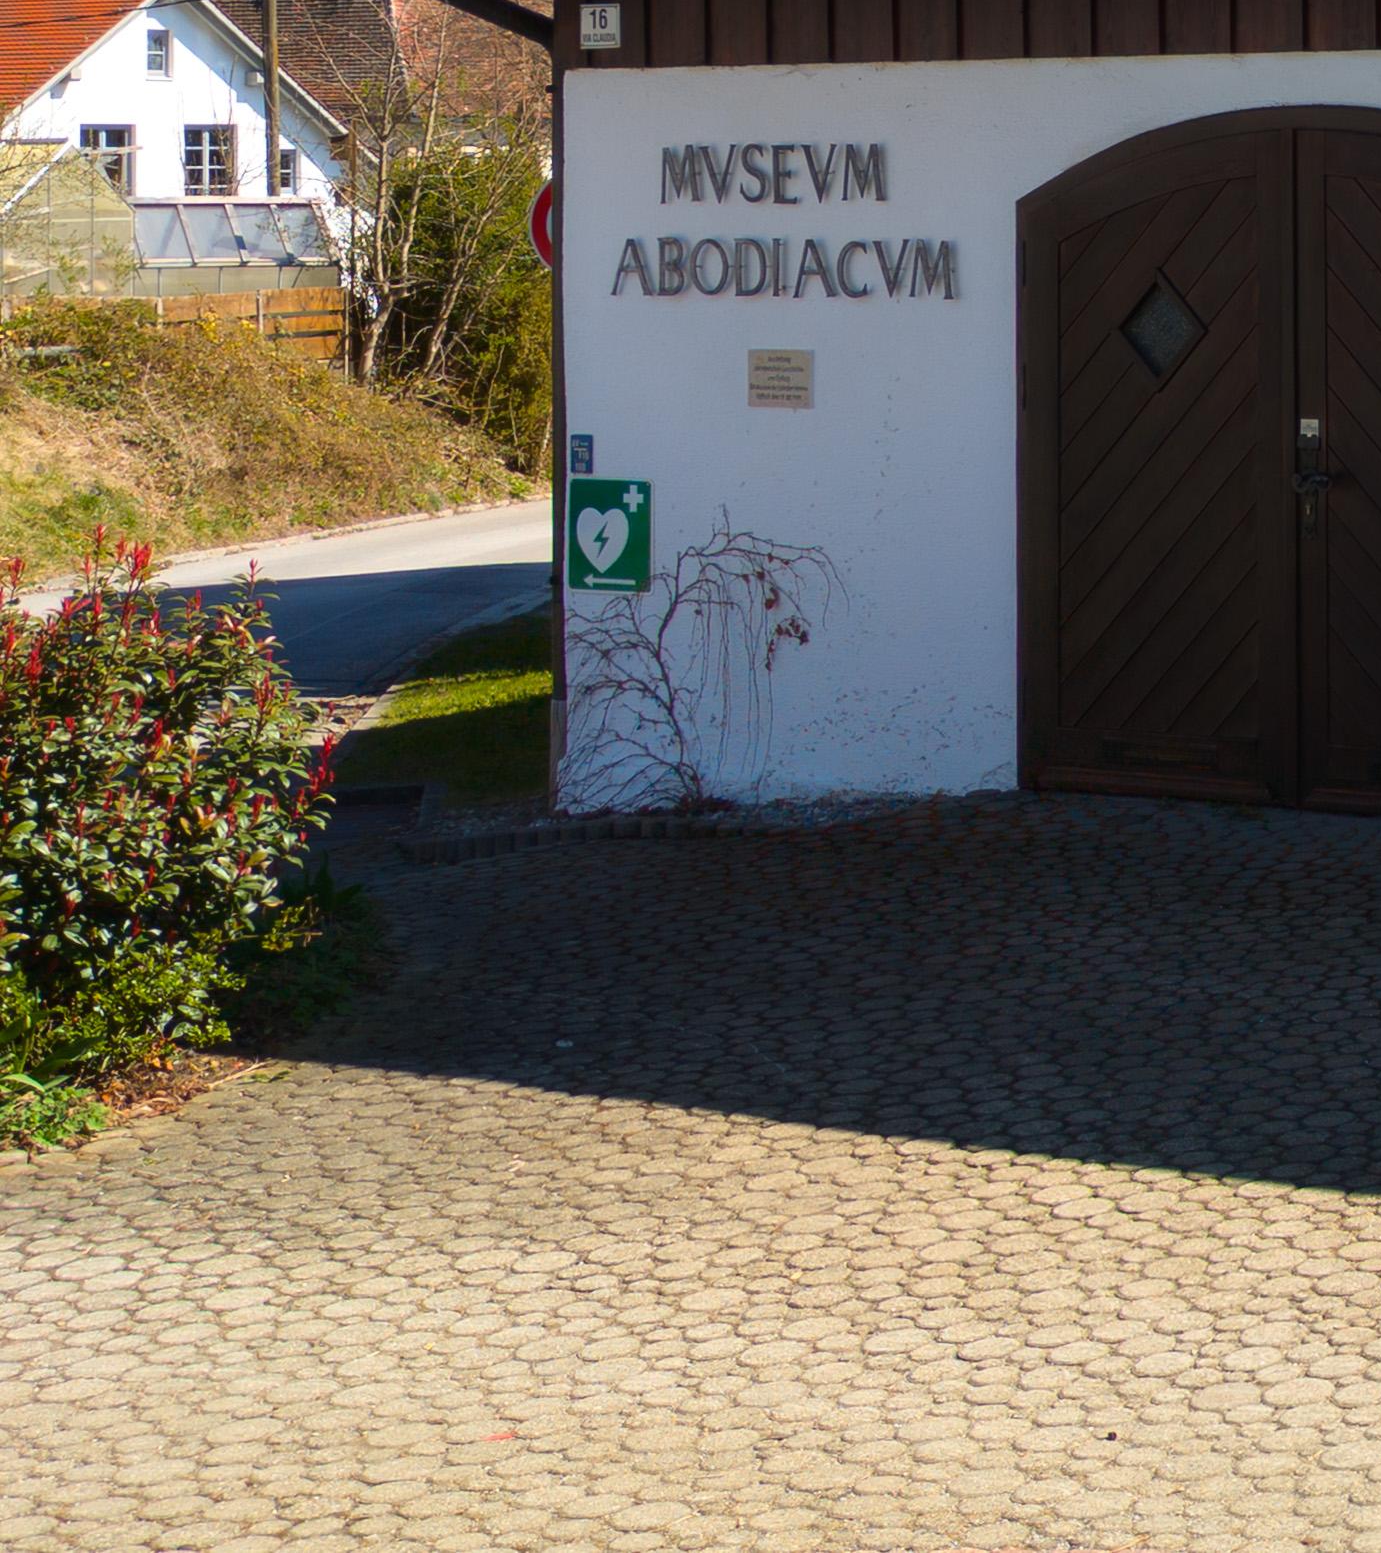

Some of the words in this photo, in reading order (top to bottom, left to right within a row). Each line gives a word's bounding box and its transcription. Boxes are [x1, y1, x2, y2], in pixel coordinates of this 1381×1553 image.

[589, 8, 608, 30] 16
[660, 143, 888, 205] MVSEVM
[610, 237, 956, 301] ABODIACVM
